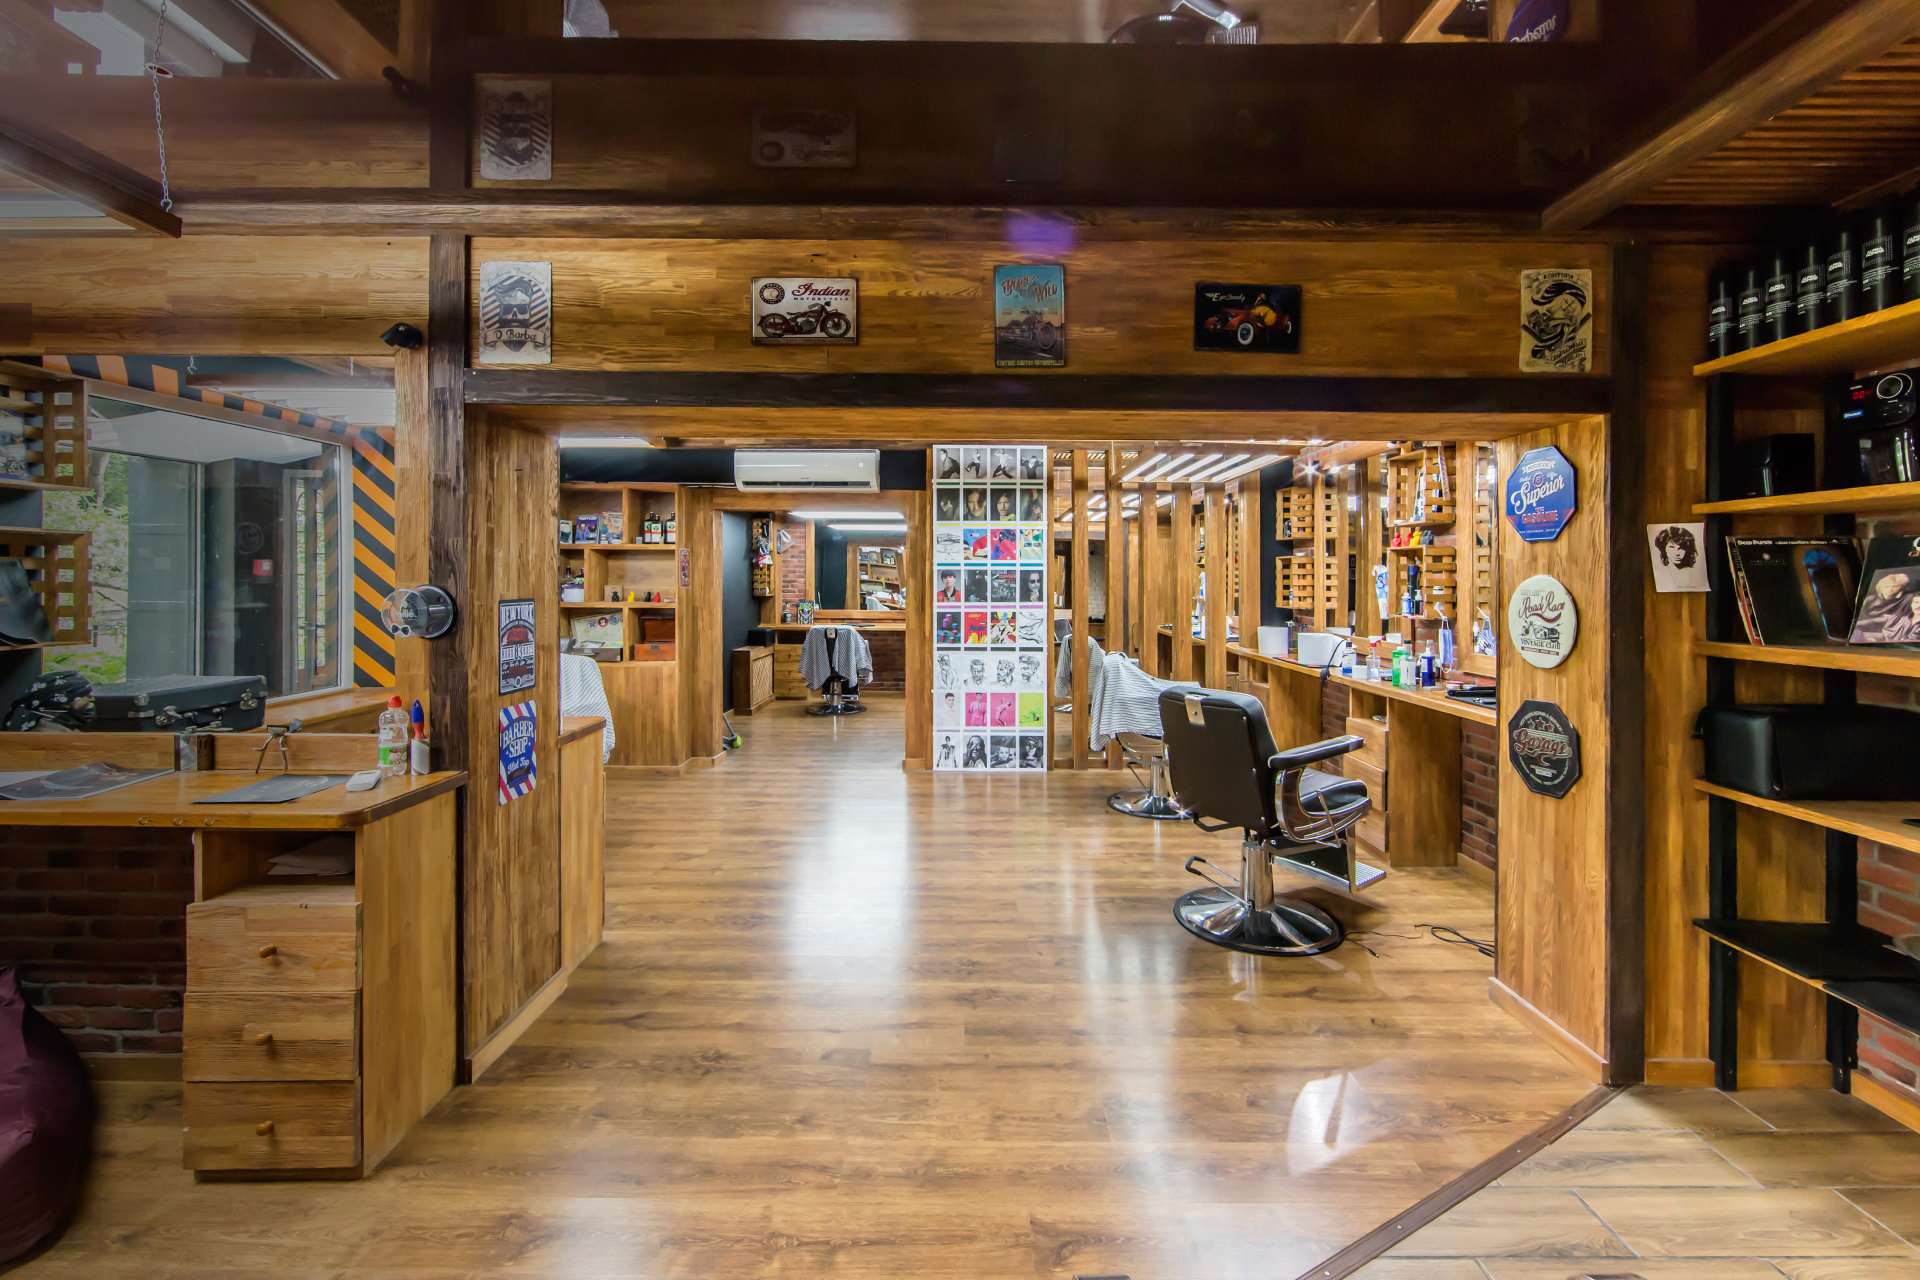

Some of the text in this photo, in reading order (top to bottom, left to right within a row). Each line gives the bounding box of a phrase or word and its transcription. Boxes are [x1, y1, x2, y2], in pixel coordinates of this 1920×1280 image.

[792, 282, 850, 297] Indian
[1511, 475, 1565, 514] Superior
[1519, 596, 1545, 619] Road
[1520, 637, 1544, 648] VINTAGE
[503, 720, 534, 750] BARBER
[509, 737, 528, 758] SHOP
